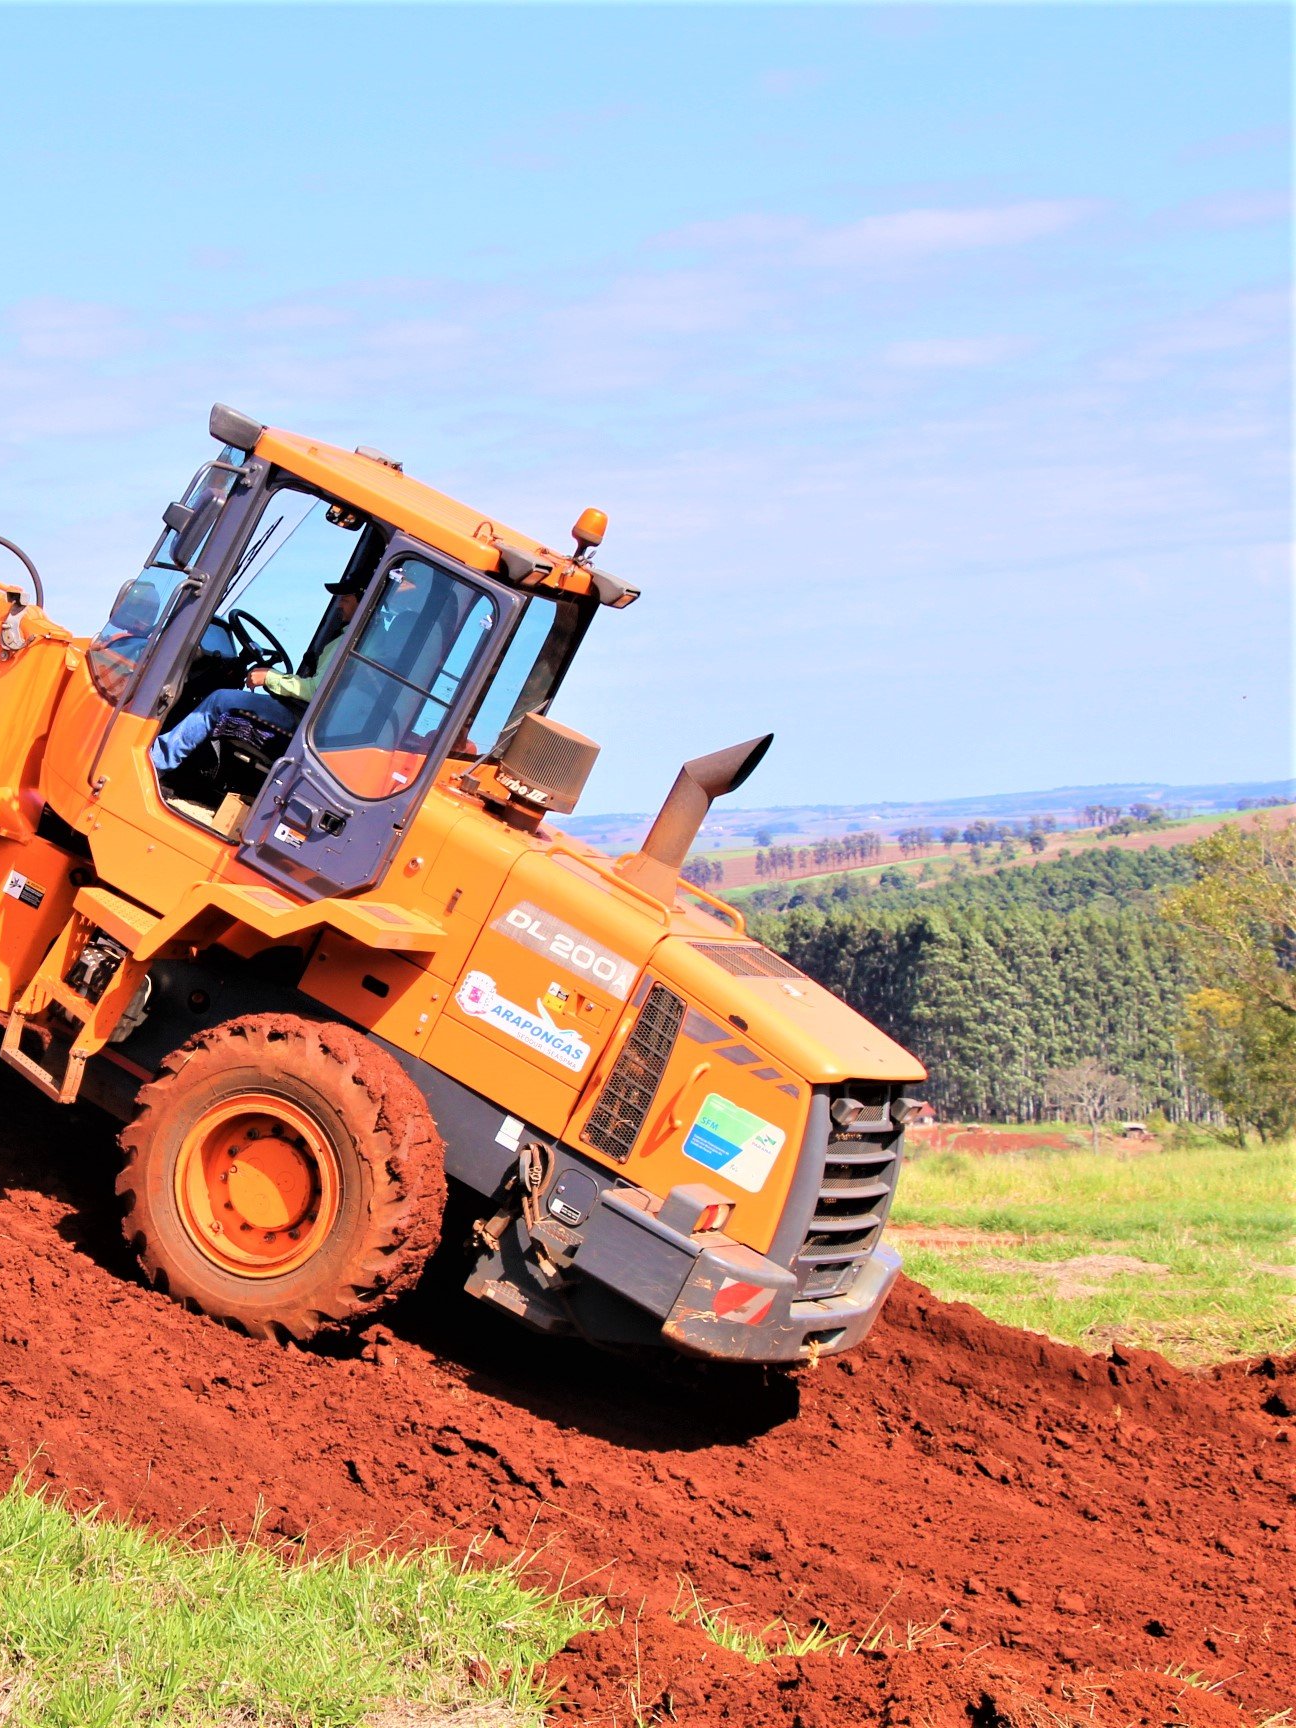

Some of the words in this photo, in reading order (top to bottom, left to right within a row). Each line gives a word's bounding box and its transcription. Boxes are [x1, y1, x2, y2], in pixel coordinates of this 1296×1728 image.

[496, 773, 528, 795] turbo
[505, 909, 548, 942] DL
[490, 1005, 584, 1060] ARAPONGAS
[700, 1116, 719, 1131] SFM
